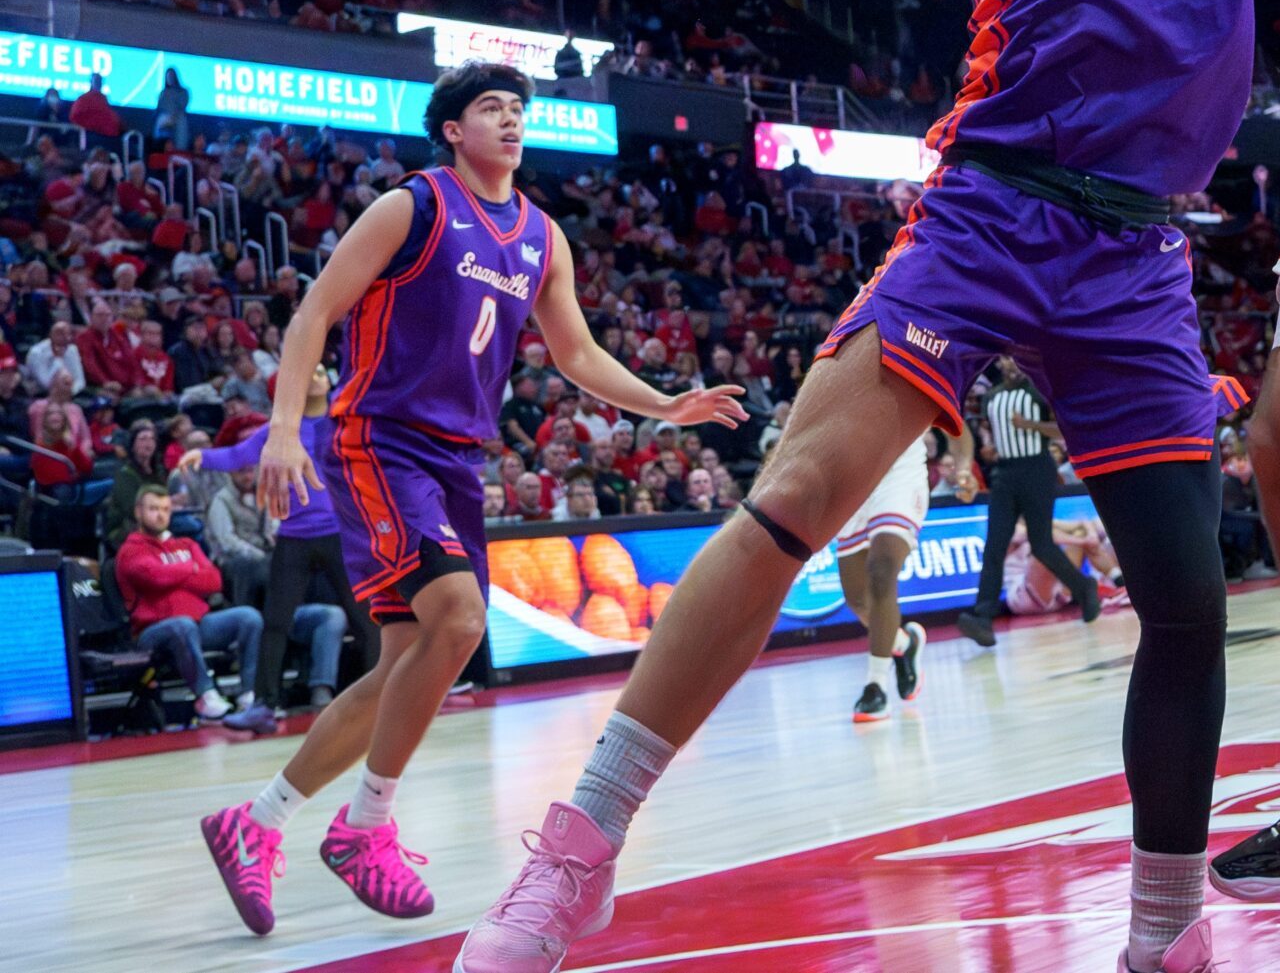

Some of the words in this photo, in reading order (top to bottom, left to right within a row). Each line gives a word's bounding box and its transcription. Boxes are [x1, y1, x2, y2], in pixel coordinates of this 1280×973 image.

[214, 64, 378, 107] HOMEFIELD
[214, 93, 280, 115] ENERGY
[523, 100, 598, 130] FIELD
[456, 251, 530, 300] Evansville
[469, 294, 497, 356] 0
[905, 321, 949, 359] VALLEY
